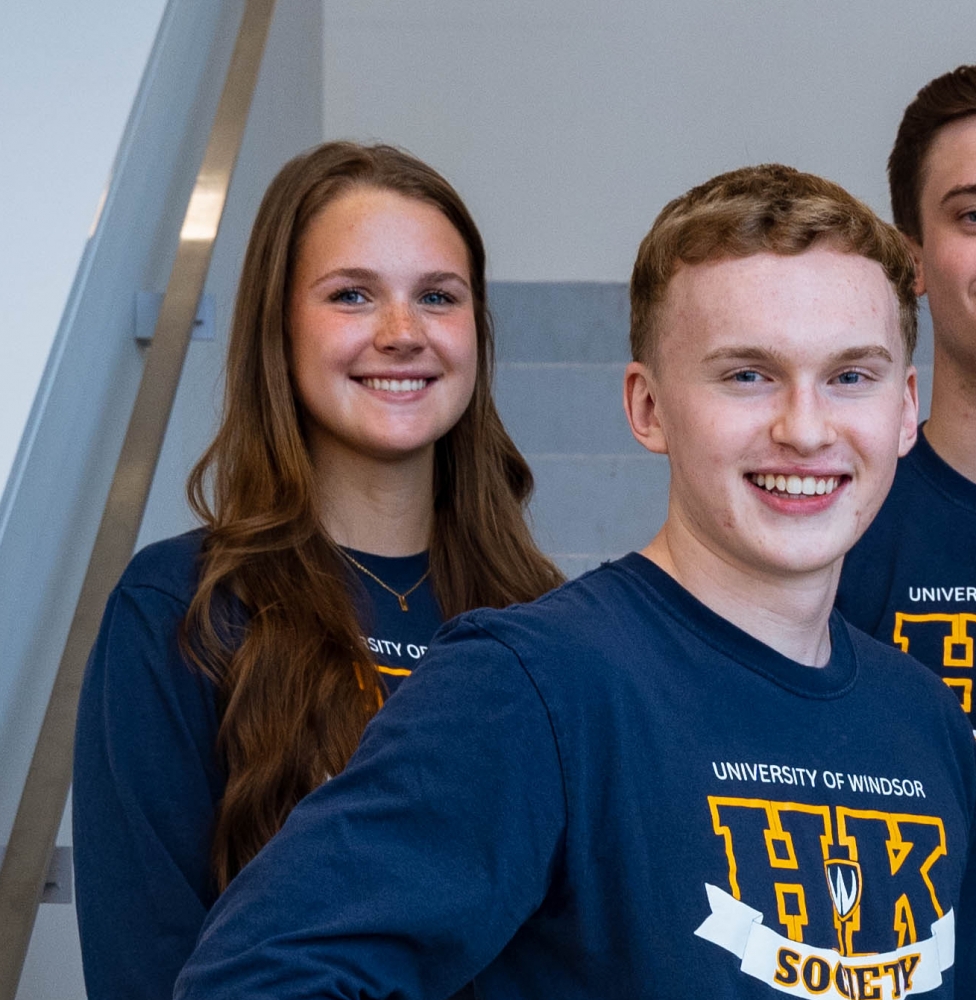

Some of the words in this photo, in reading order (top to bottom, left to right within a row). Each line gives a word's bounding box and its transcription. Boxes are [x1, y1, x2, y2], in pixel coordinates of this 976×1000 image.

[712, 761, 817, 788] UNIVERSITY
[823, 770, 845, 790] OF
[847, 773, 926, 799] WINDSOR
